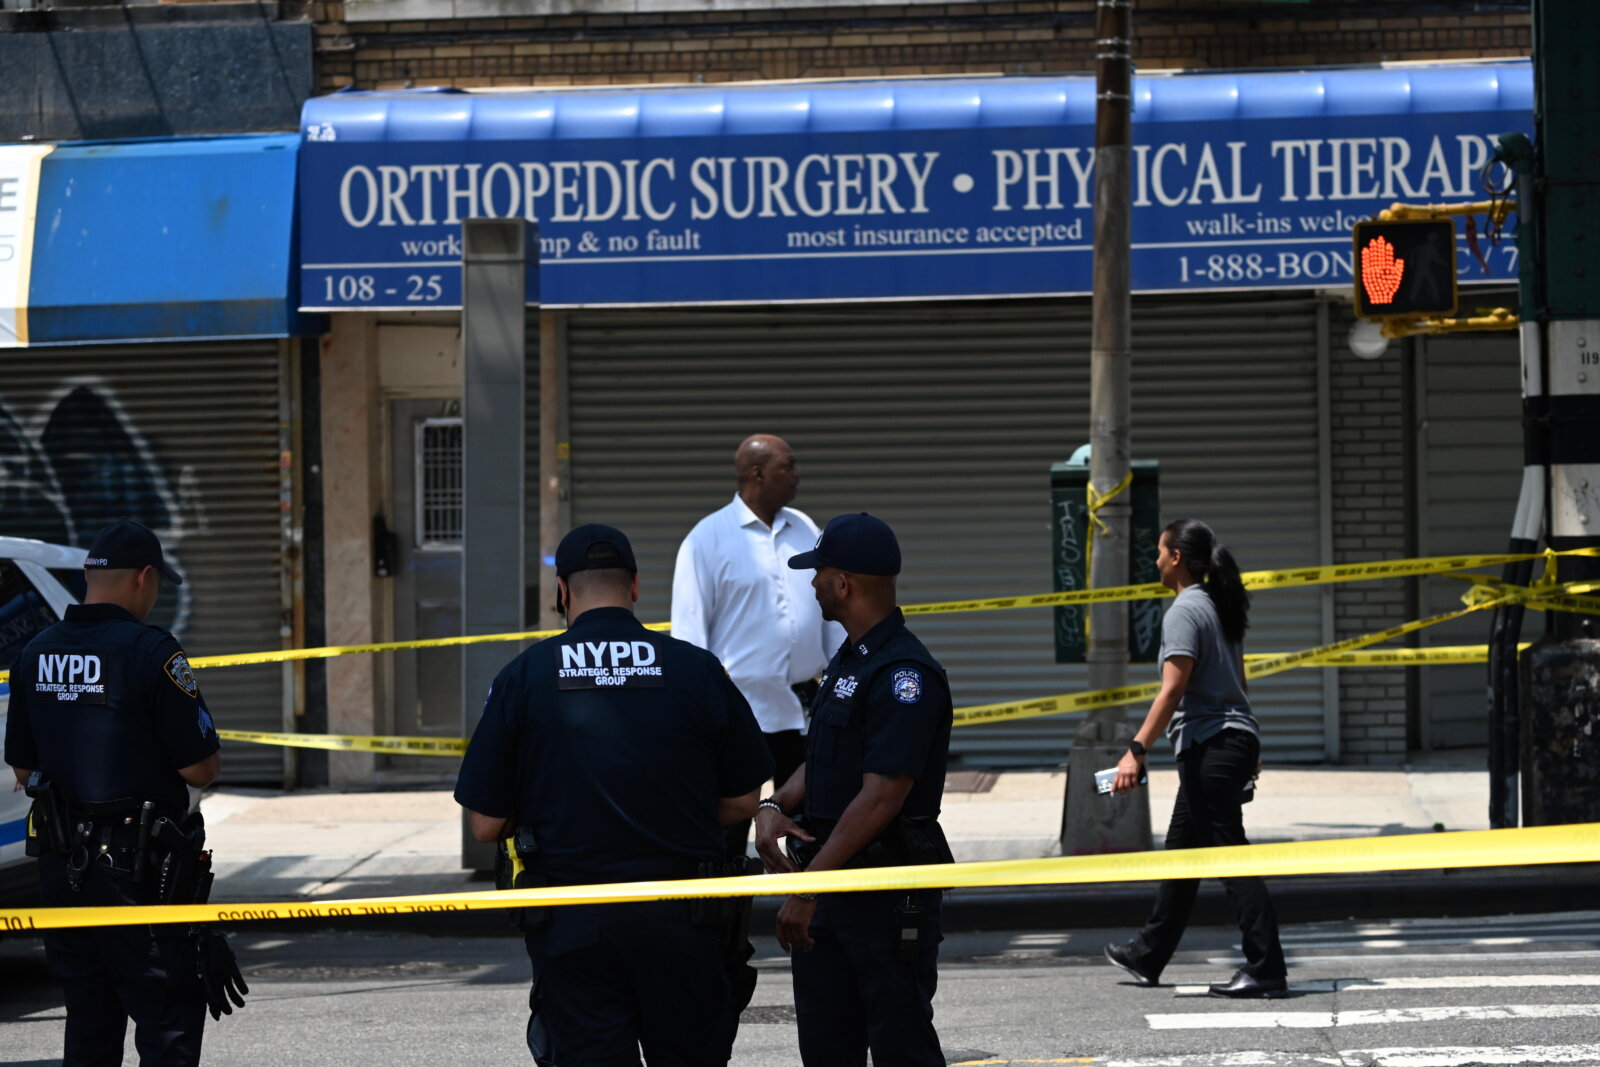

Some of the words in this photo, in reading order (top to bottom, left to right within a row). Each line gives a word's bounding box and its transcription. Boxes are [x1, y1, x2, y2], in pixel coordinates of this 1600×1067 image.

[340, 158, 677, 228] ORTHOPEDIC
[690, 152, 940, 220] SURGERY
[992, 141, 1263, 211] PHYICAL
[787, 228, 846, 247] most
[853, 224, 969, 246] insurance
[976, 218, 1082, 246] accepted
[1186, 211, 1292, 236] walk-ins
[577, 231, 601, 253] &
[609, 236, 639, 252] no
[646, 229, 701, 251] fault
[324, 274, 376, 301] 108
[406, 274, 443, 301] 25
[561, 640, 656, 669] NYPD
[38, 653, 101, 684] NYPD
[559, 667, 610, 678] STRATEGIC
[613, 666, 662, 676] RESPONSE
[894, 670, 920, 682] POLICE
[35, 683, 68, 692] STRATEGIC
[69, 684, 105, 693] RESPONSE
[595, 676, 627, 686] GROUP
[834, 677, 859, 693] POLICE
[57, 692, 79, 701] GROUP
